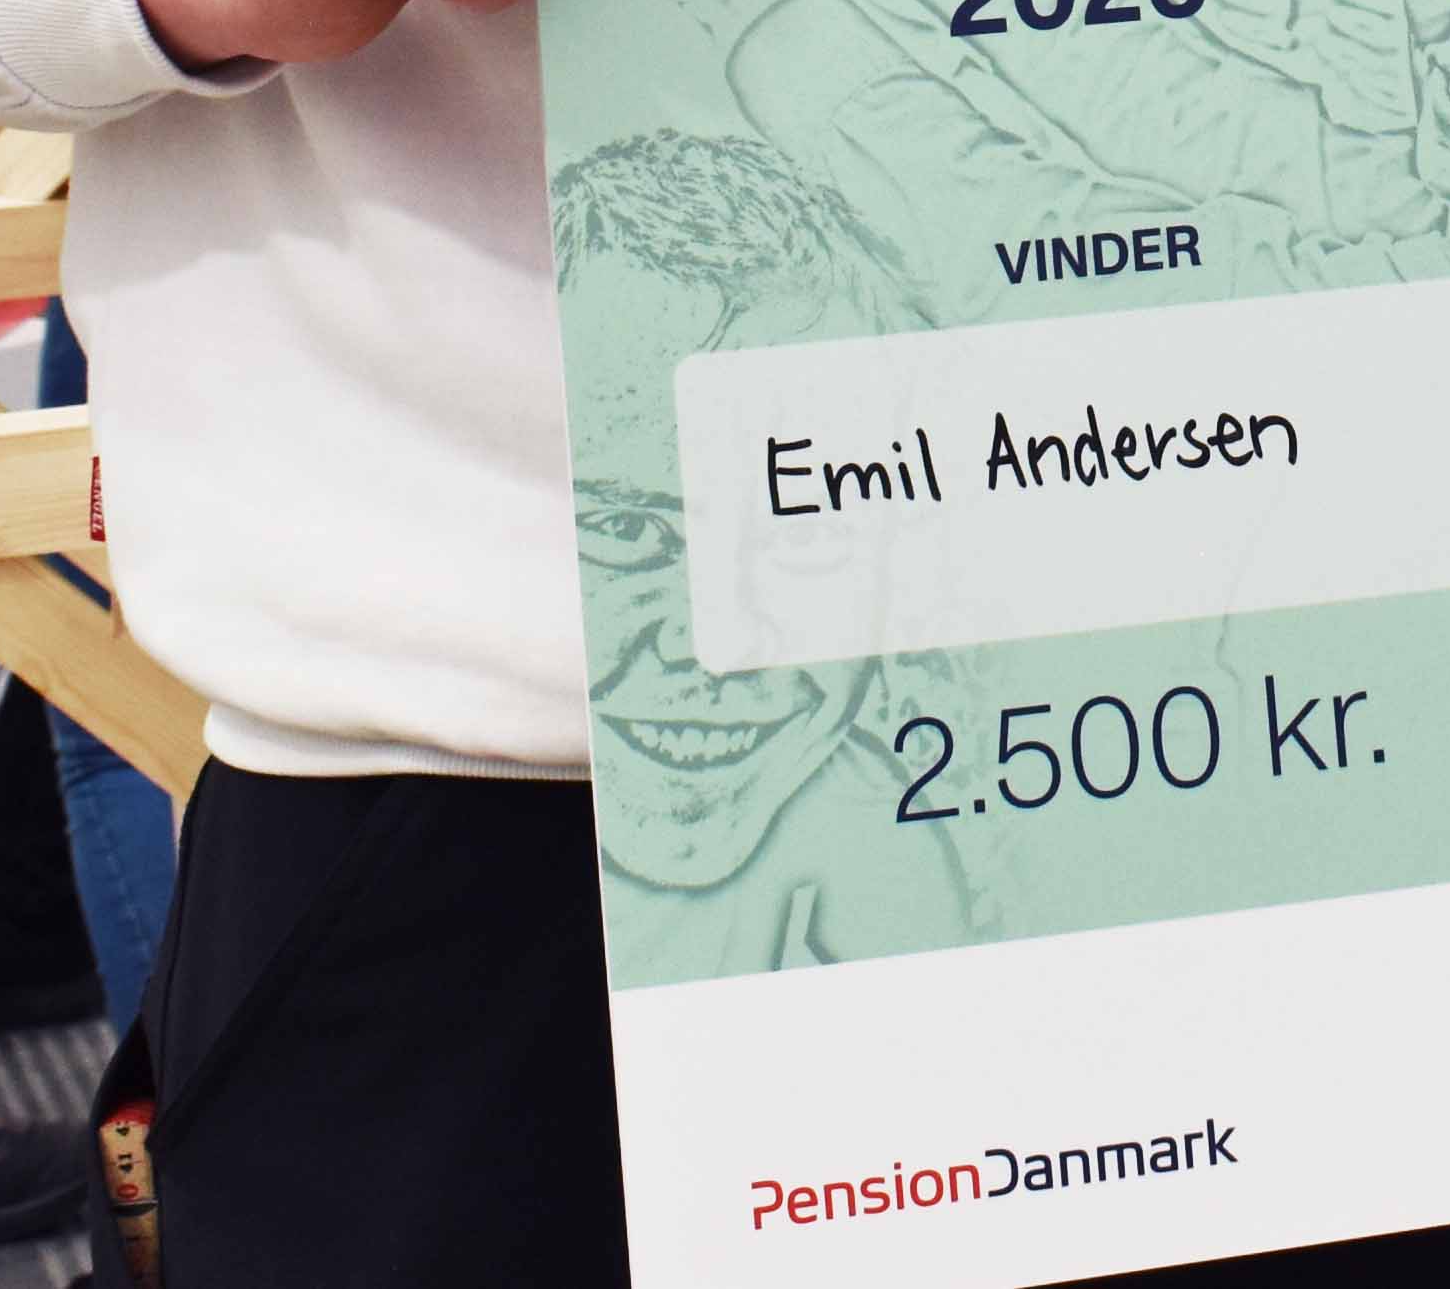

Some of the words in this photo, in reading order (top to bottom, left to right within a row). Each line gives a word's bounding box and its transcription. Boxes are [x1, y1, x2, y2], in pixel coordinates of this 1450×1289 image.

[994, 225, 1202, 285] VINDER
[767, 428, 942, 516] Emil
[986, 405, 1298, 491] Andersen
[893, 685, 1220, 824] 2.500
[1264, 675, 1388, 778] kr.
[751, 1118, 1238, 1231] PensionDanmark
